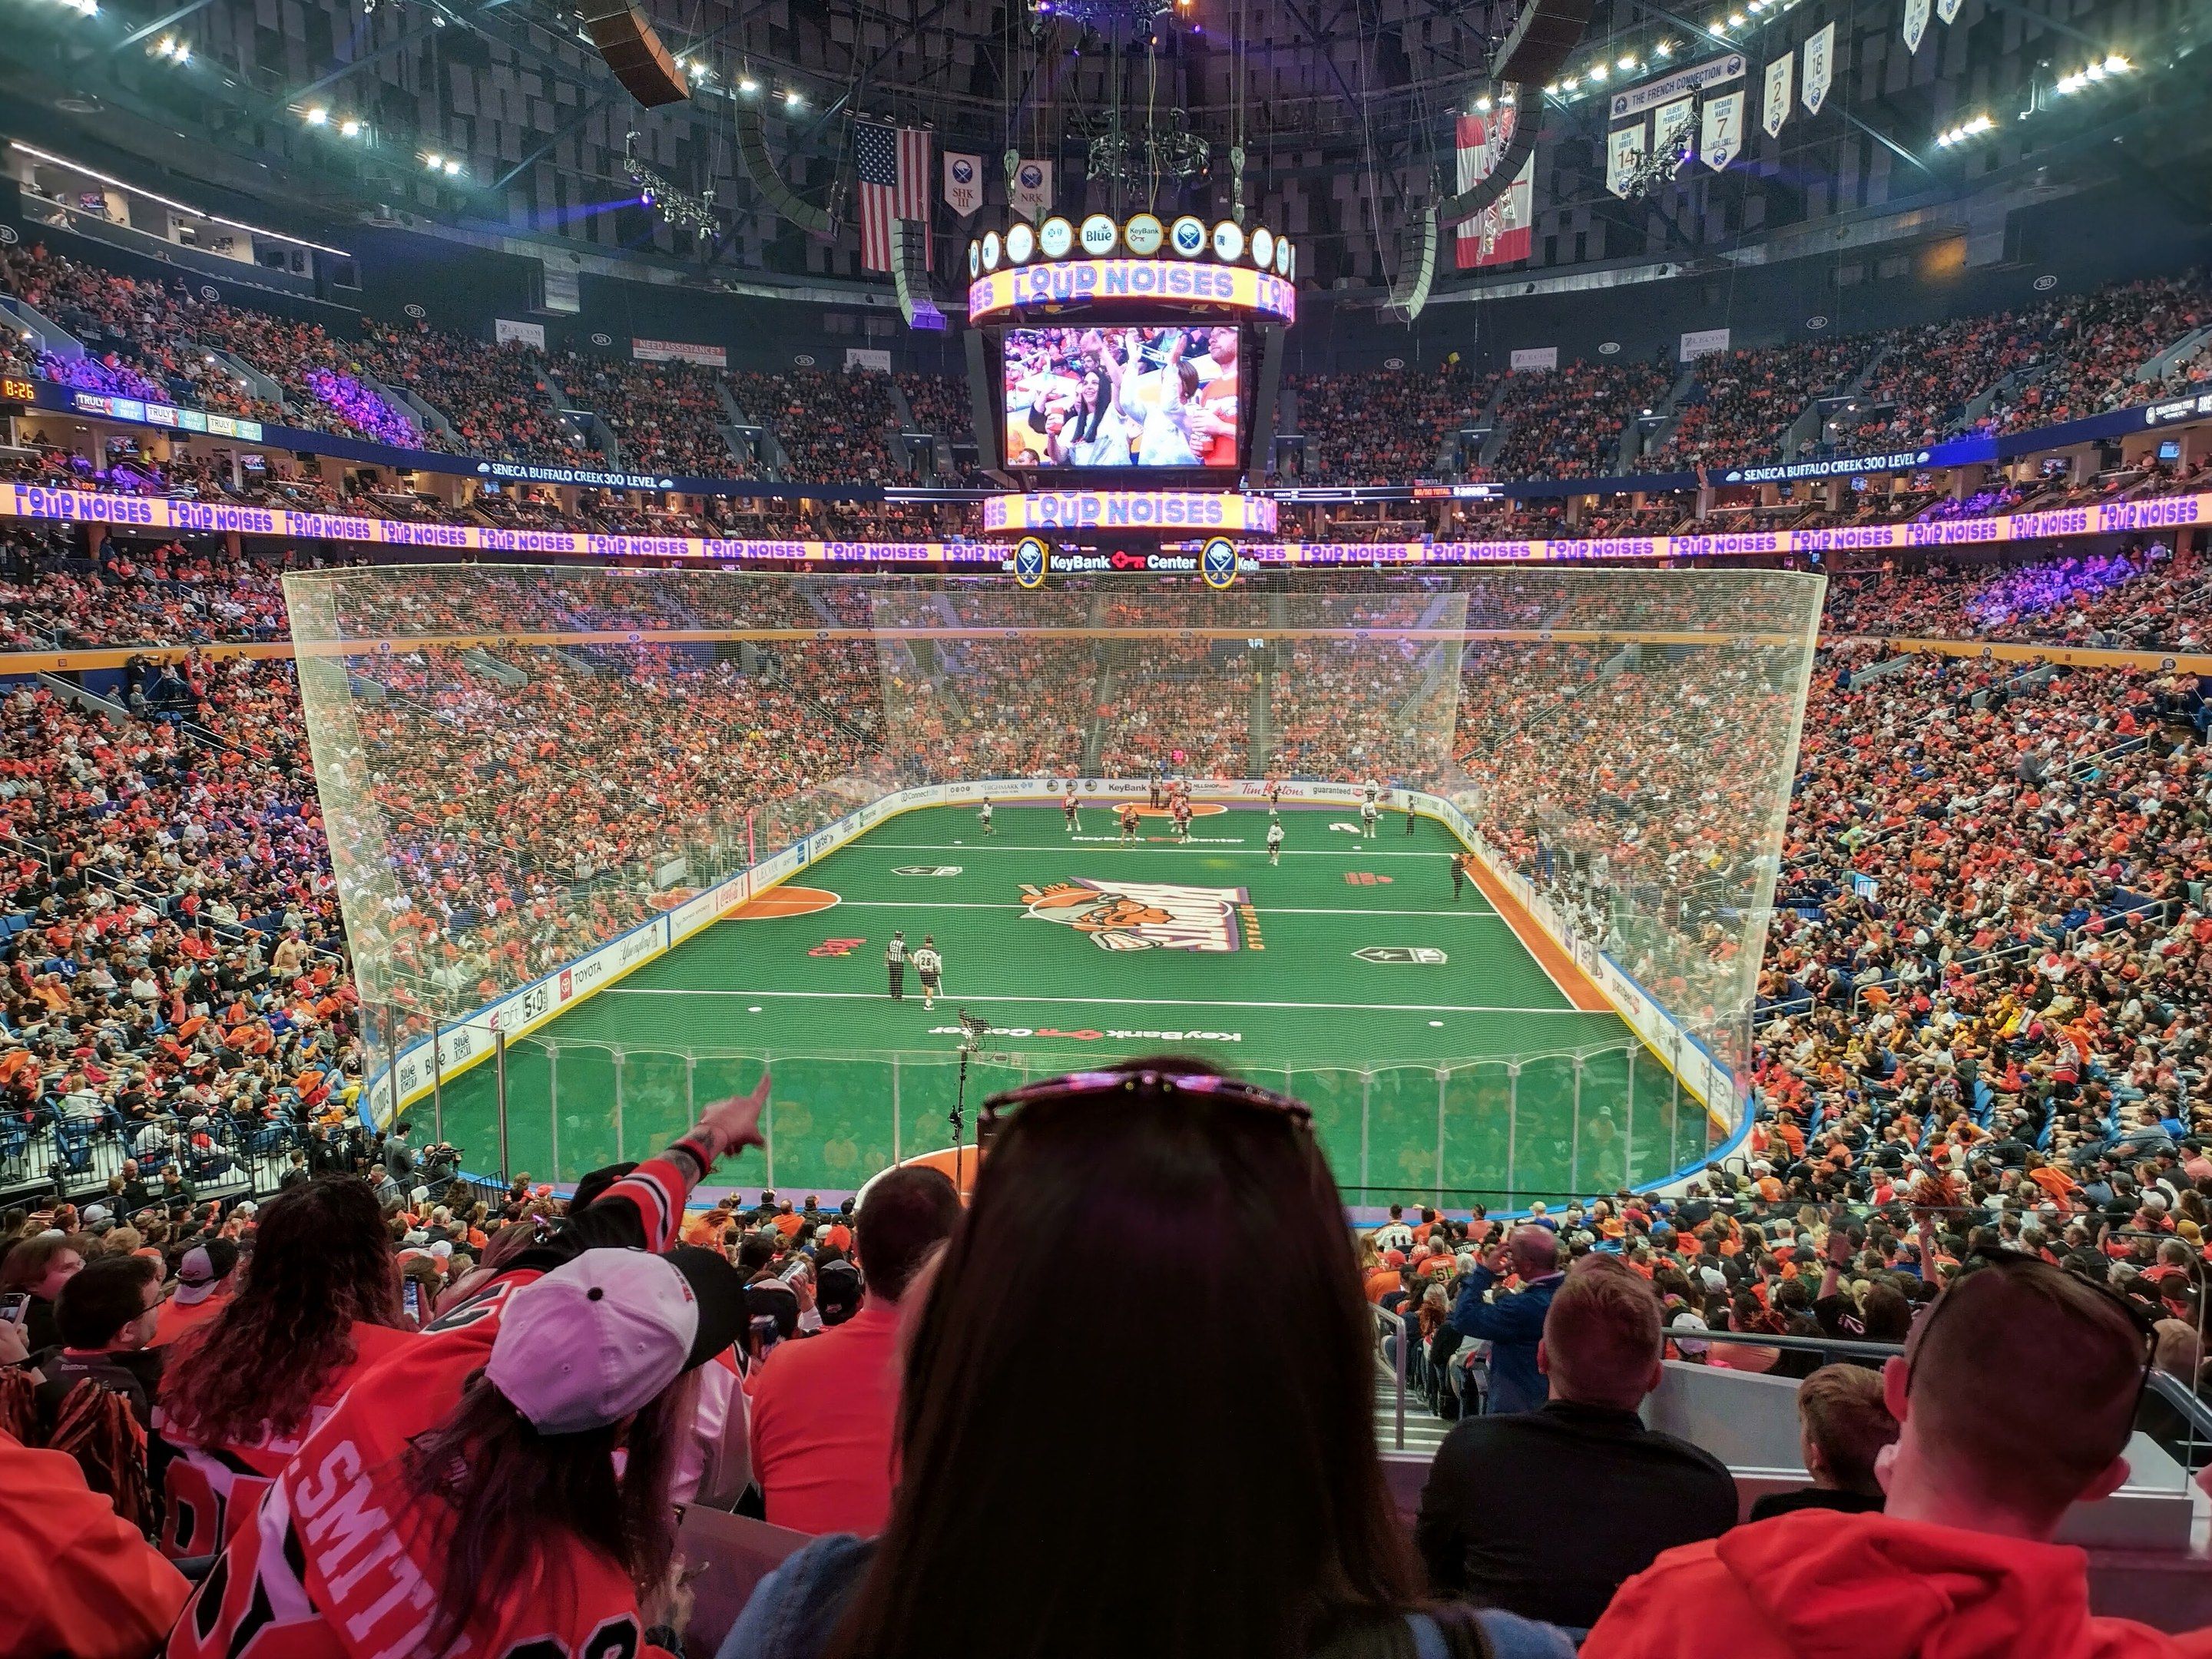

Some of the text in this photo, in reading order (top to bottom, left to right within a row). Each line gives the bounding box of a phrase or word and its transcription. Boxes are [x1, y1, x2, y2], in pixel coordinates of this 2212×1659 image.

[1813, 53, 1823, 78] 18
[1632, 65, 1722, 105] THE FRENCH CONNECTION
[1773, 81, 1781, 104] 2
[1717, 118, 1728, 138] 7
[1618, 149, 1634, 168] 14
[1021, 193, 1043, 204] NRK
[1086, 230, 1112, 243] Blue
[1129, 226, 1159, 237] KeyBank
[1105, 266, 1235, 298] NOISES
[639, 339, 722, 355] NEED ASSISTANCE?
[5, 380, 35, 399] 8:26
[79, 393, 135, 410] TRULY LIVE
[2155, 402, 2182, 416] SOUTHERN
[2182, 400, 2194, 409] TIER
[119, 408, 139, 418] TRULY
[148, 406, 170, 418] TRULY
[210, 418, 255, 432] TRULY LIVE
[492, 463, 657, 488] SENECA BUFFALO CREEK 300 LEVEL
[1744, 453, 1915, 482] SENECA BUFFALO CREEK 300 LEVEL
[79, 496, 152, 523] NOISES
[1108, 498, 1223, 525] NOISES
[2139, 502, 2198, 528] NOISES
[216, 509, 273, 531] NOISES
[325, 519, 371, 538] NOISES
[2041, 513, 2087, 536] NOISES
[414, 528, 467, 545] NOISES
[1836, 528, 1893, 548] NOISES
[1945, 523, 1997, 541] NOISES
[518, 534, 575, 551] NOISES
[631, 539, 689, 555] NOISES
[747, 543, 806, 559] NOISES
[1592, 541, 1654, 558] NOISES
[1715, 536, 1777, 555] NOISES
[869, 546, 929, 560] NOISES
[1348, 547, 1409, 561] NOISES
[1470, 545, 1531, 559] NOISES
[1050, 554, 1197, 571] KeyBank Center
[1108, 783, 1147, 792] KeyBank
[1242, 783, 1262, 796] Tim
[1313, 786, 1351, 796] guaranteed
[1239, 903, 1265, 950] BUFFALO
[921, 957, 931, 966] 28
[575, 961, 602, 985] TOYOTA
[453, 1032, 469, 1049] Blue
[1106, 1029, 1242, 1041] KeyBank
[399, 1062, 416, 1081] Blue
[425, 1051, 446, 1075] Ble
